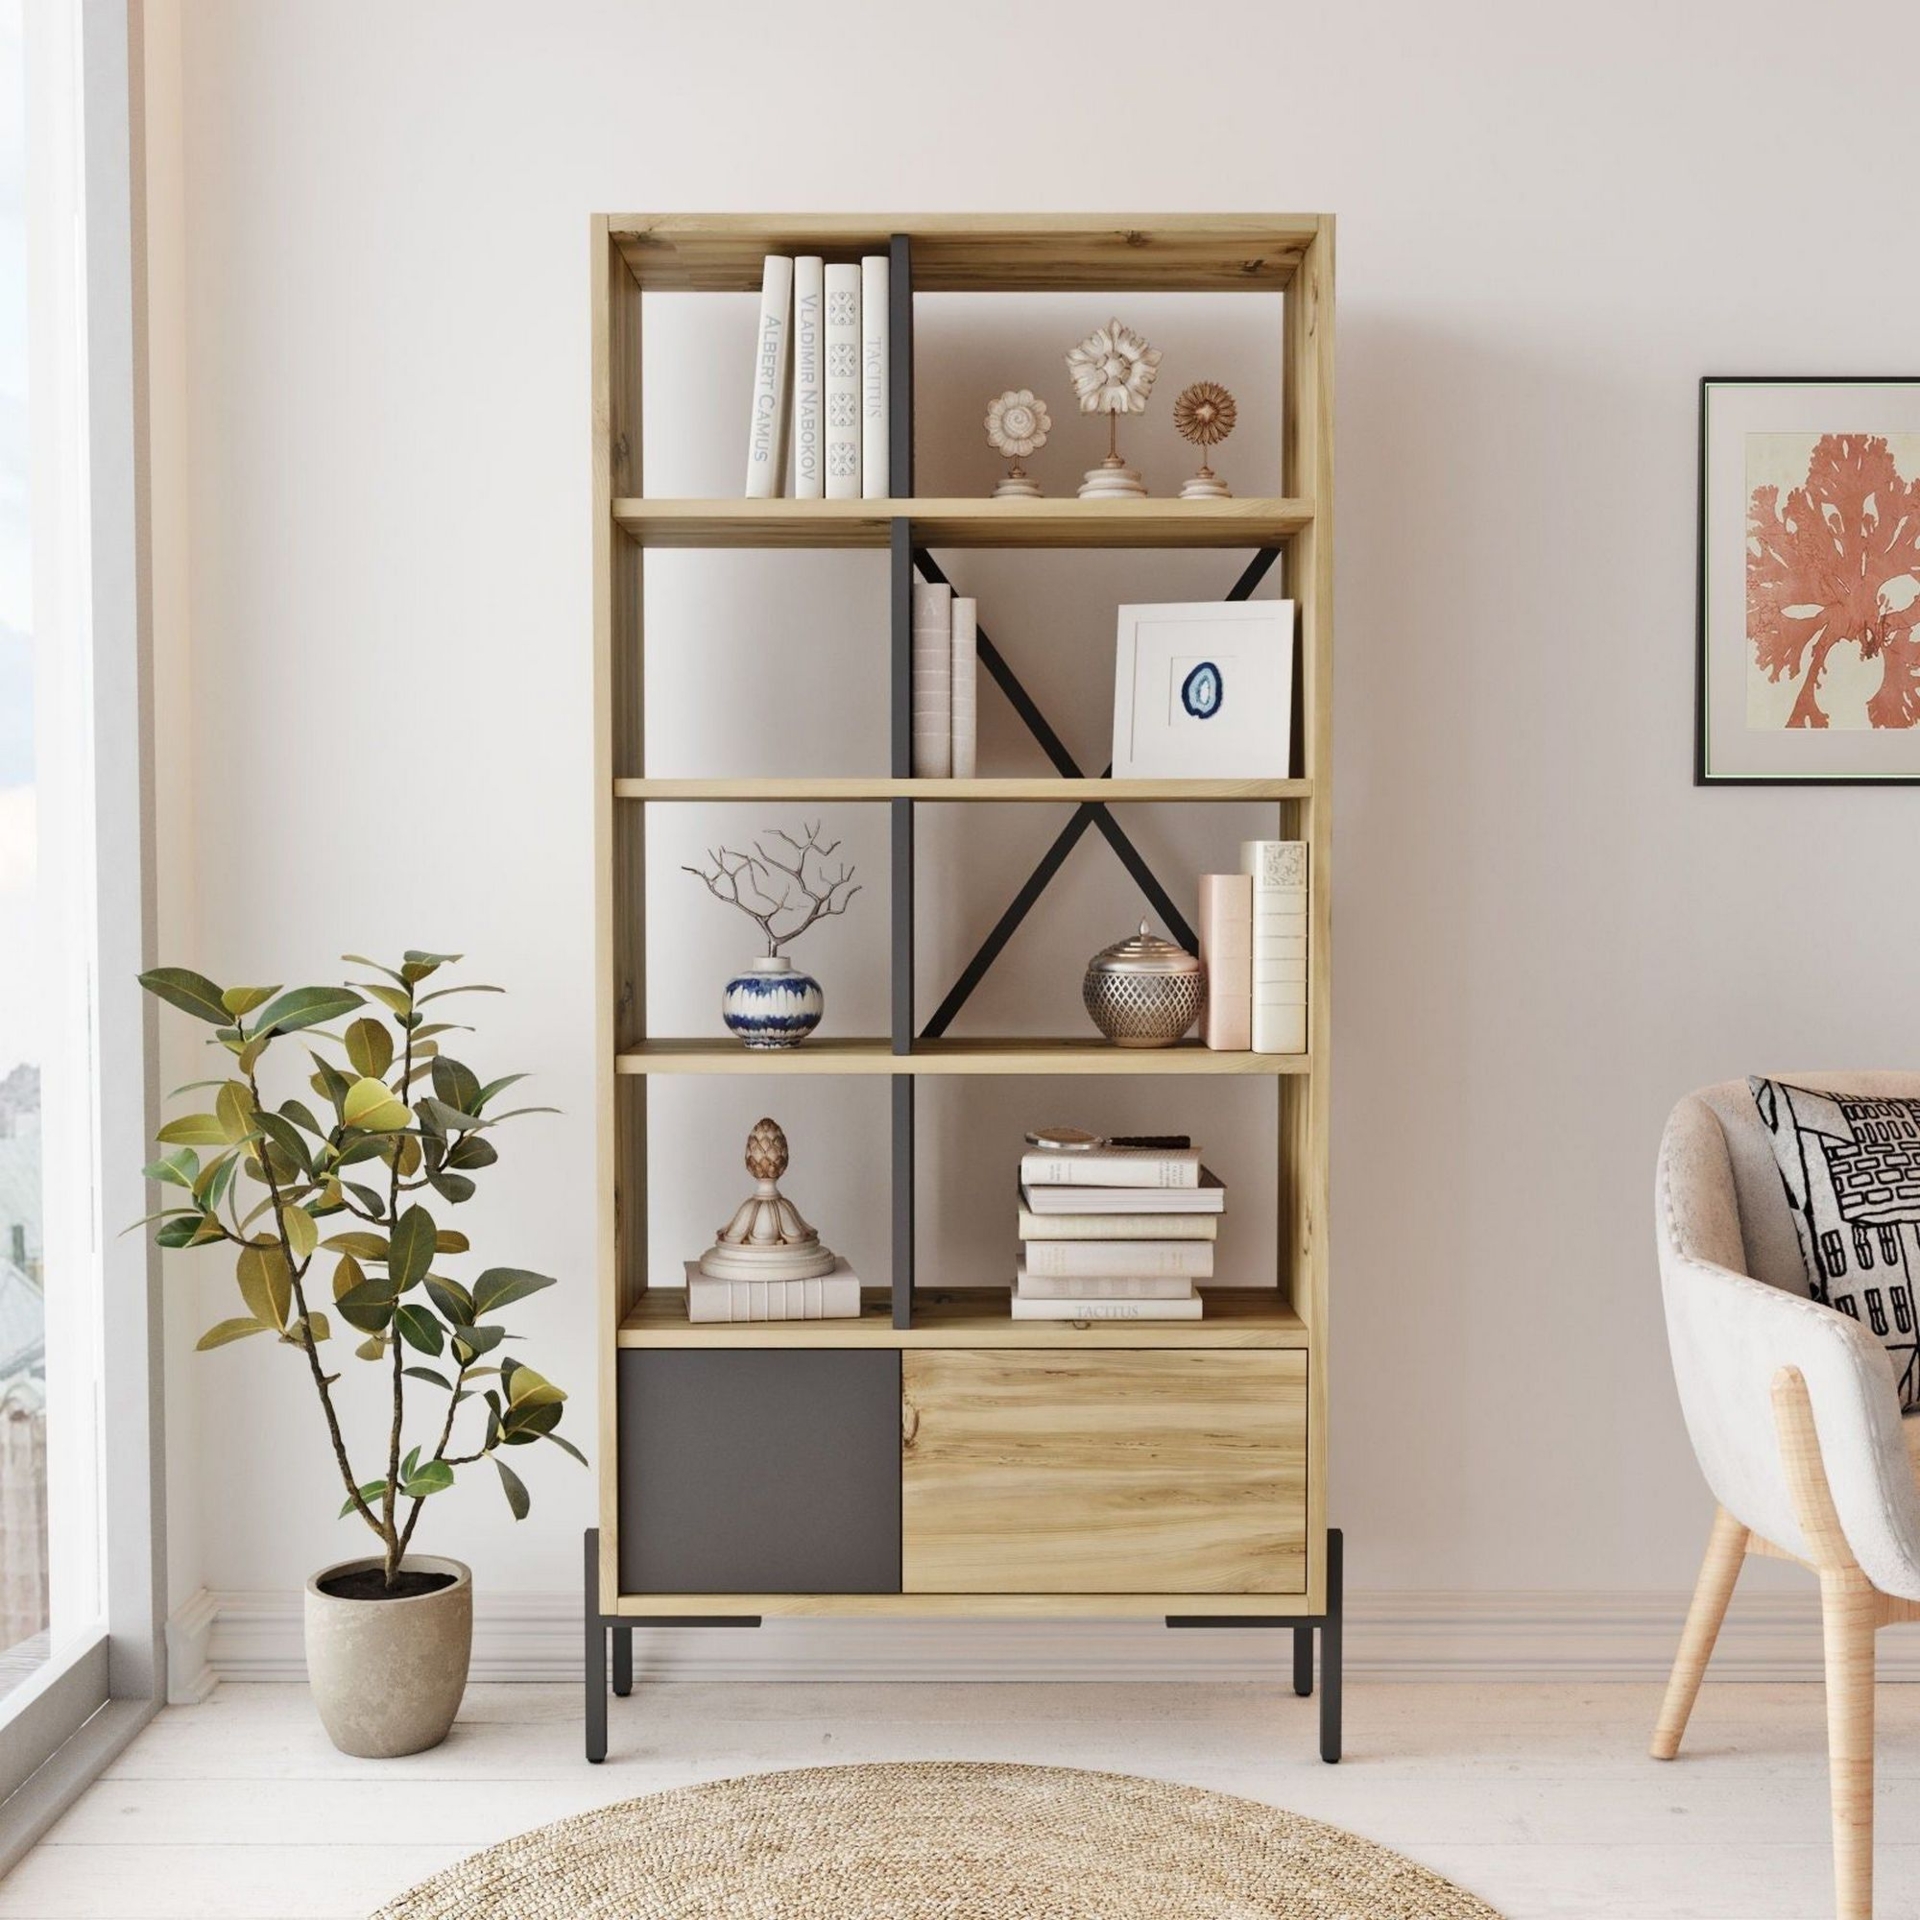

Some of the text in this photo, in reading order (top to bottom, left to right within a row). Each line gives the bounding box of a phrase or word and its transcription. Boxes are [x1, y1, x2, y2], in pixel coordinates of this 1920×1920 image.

[754, 315, 782, 463] ALBERT CAMUS
[801, 294, 818, 481] VLADIMIR NABOKOV
[867, 337, 882, 418] TACITUS
[1076, 1305, 1139, 1319] TACITUS
